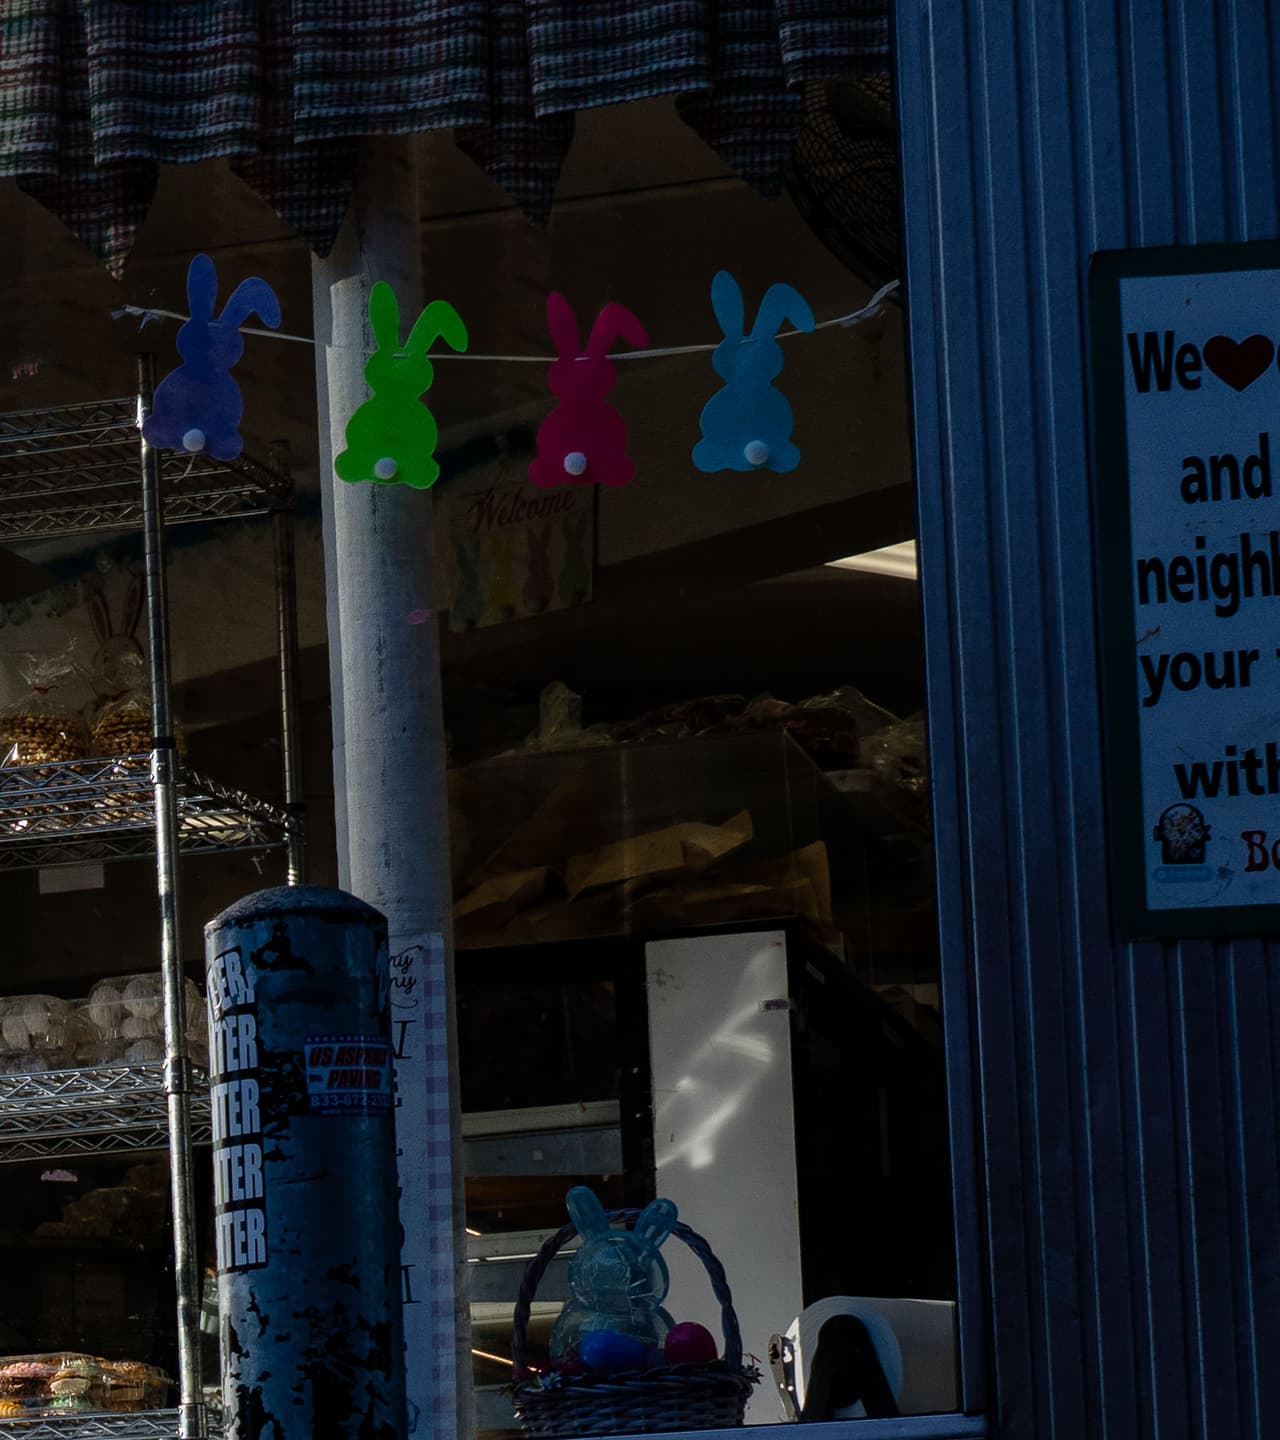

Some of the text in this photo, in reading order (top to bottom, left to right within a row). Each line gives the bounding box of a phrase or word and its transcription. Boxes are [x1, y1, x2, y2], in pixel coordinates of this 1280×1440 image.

[1127, 330, 1203, 393] We
[1180, 432, 1273, 504] and
[468, 488, 577, 534] Welcome
[1140, 649, 1260, 708] your
